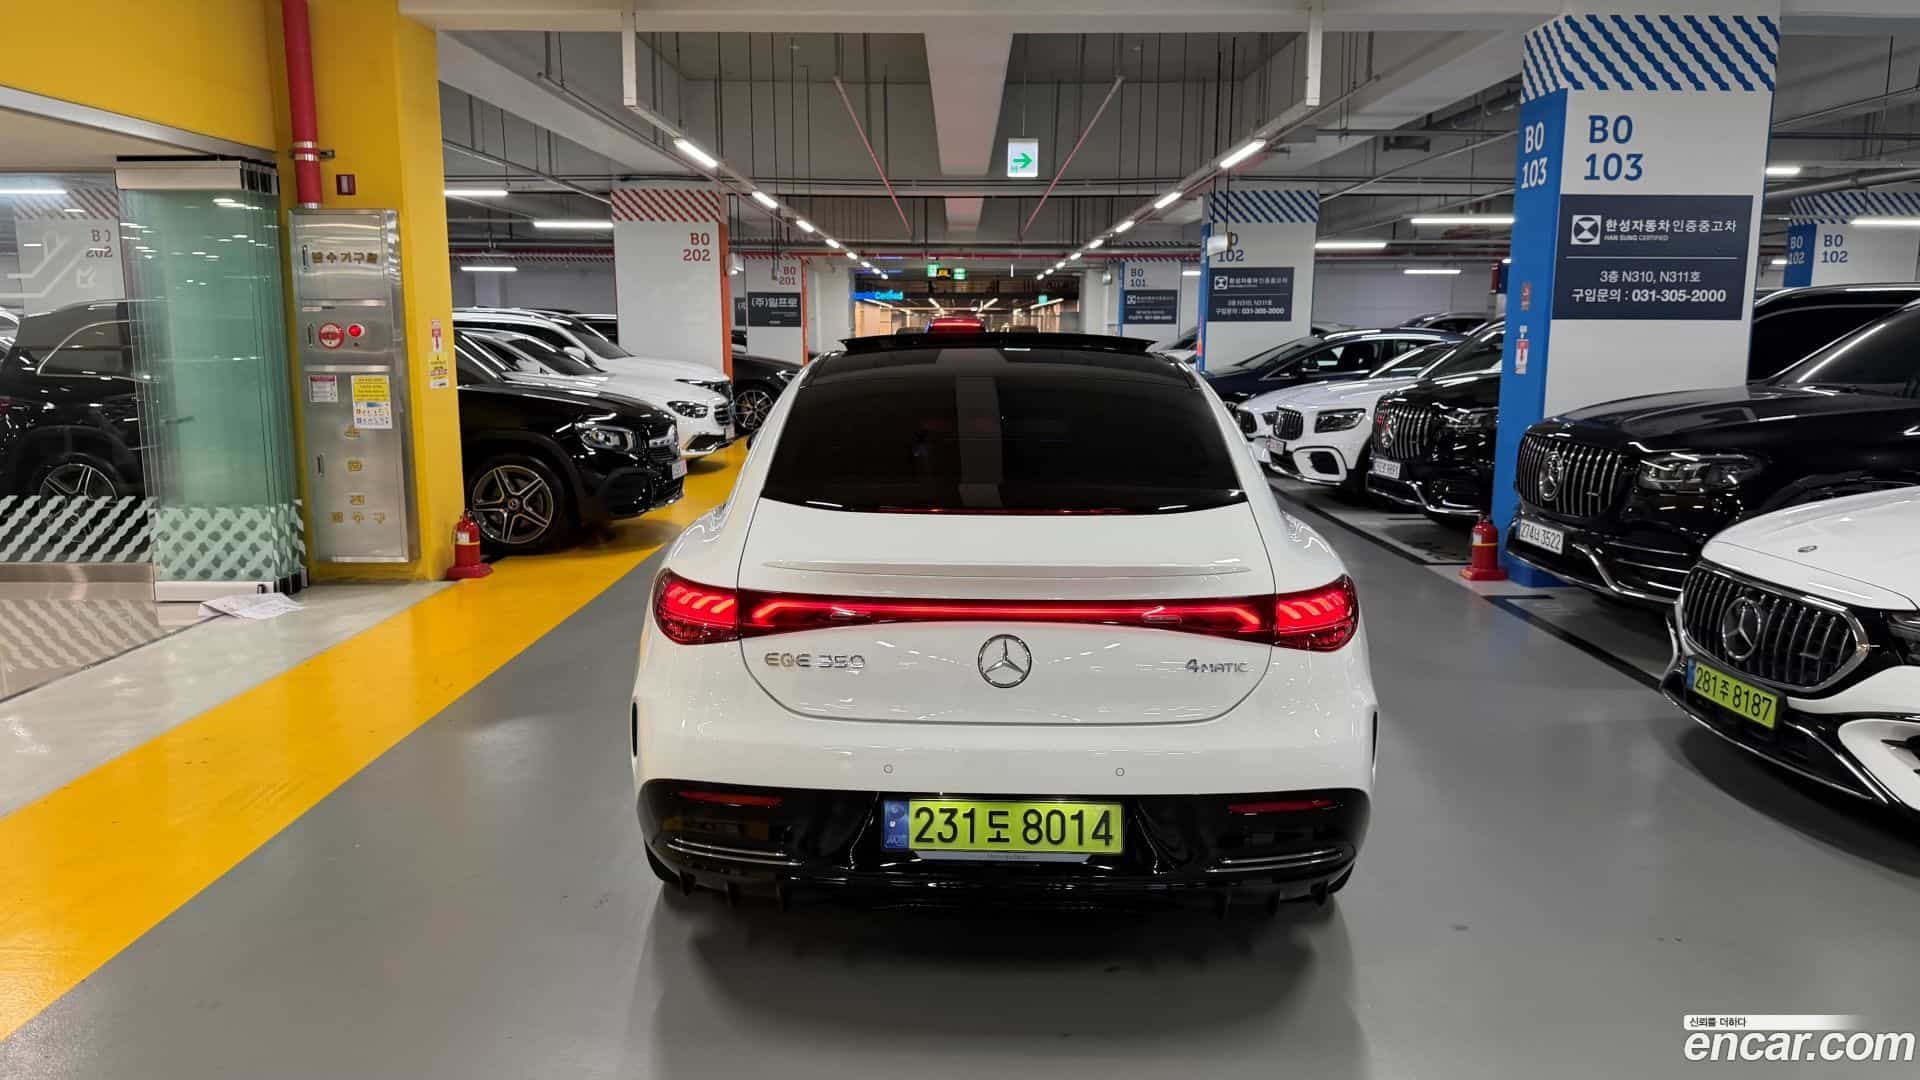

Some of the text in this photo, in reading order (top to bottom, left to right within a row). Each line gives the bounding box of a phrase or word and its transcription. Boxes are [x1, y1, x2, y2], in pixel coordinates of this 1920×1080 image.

[1521, 156, 1548, 189] 103
[1583, 152, 1643, 181] 103
[1605, 219, 1737, 233] 한성자동차 인증중고차
[683, 248, 711, 262] 202
[1217, 249, 1245, 263] 102
[1789, 251, 1805, 265] 102
[1820, 250, 1848, 264] 102
[779, 276, 797, 286] 201
[1130, 278, 1146, 288] 101
[1600, 270, 1701, 285] 3층 N310, N311호
[1572, 288, 1621, 303] 구입문의
[1631, 289, 1727, 303] 031-305-2000
[764, 652, 866, 670] EQE 350
[1022, 807, 1113, 847] 8014
